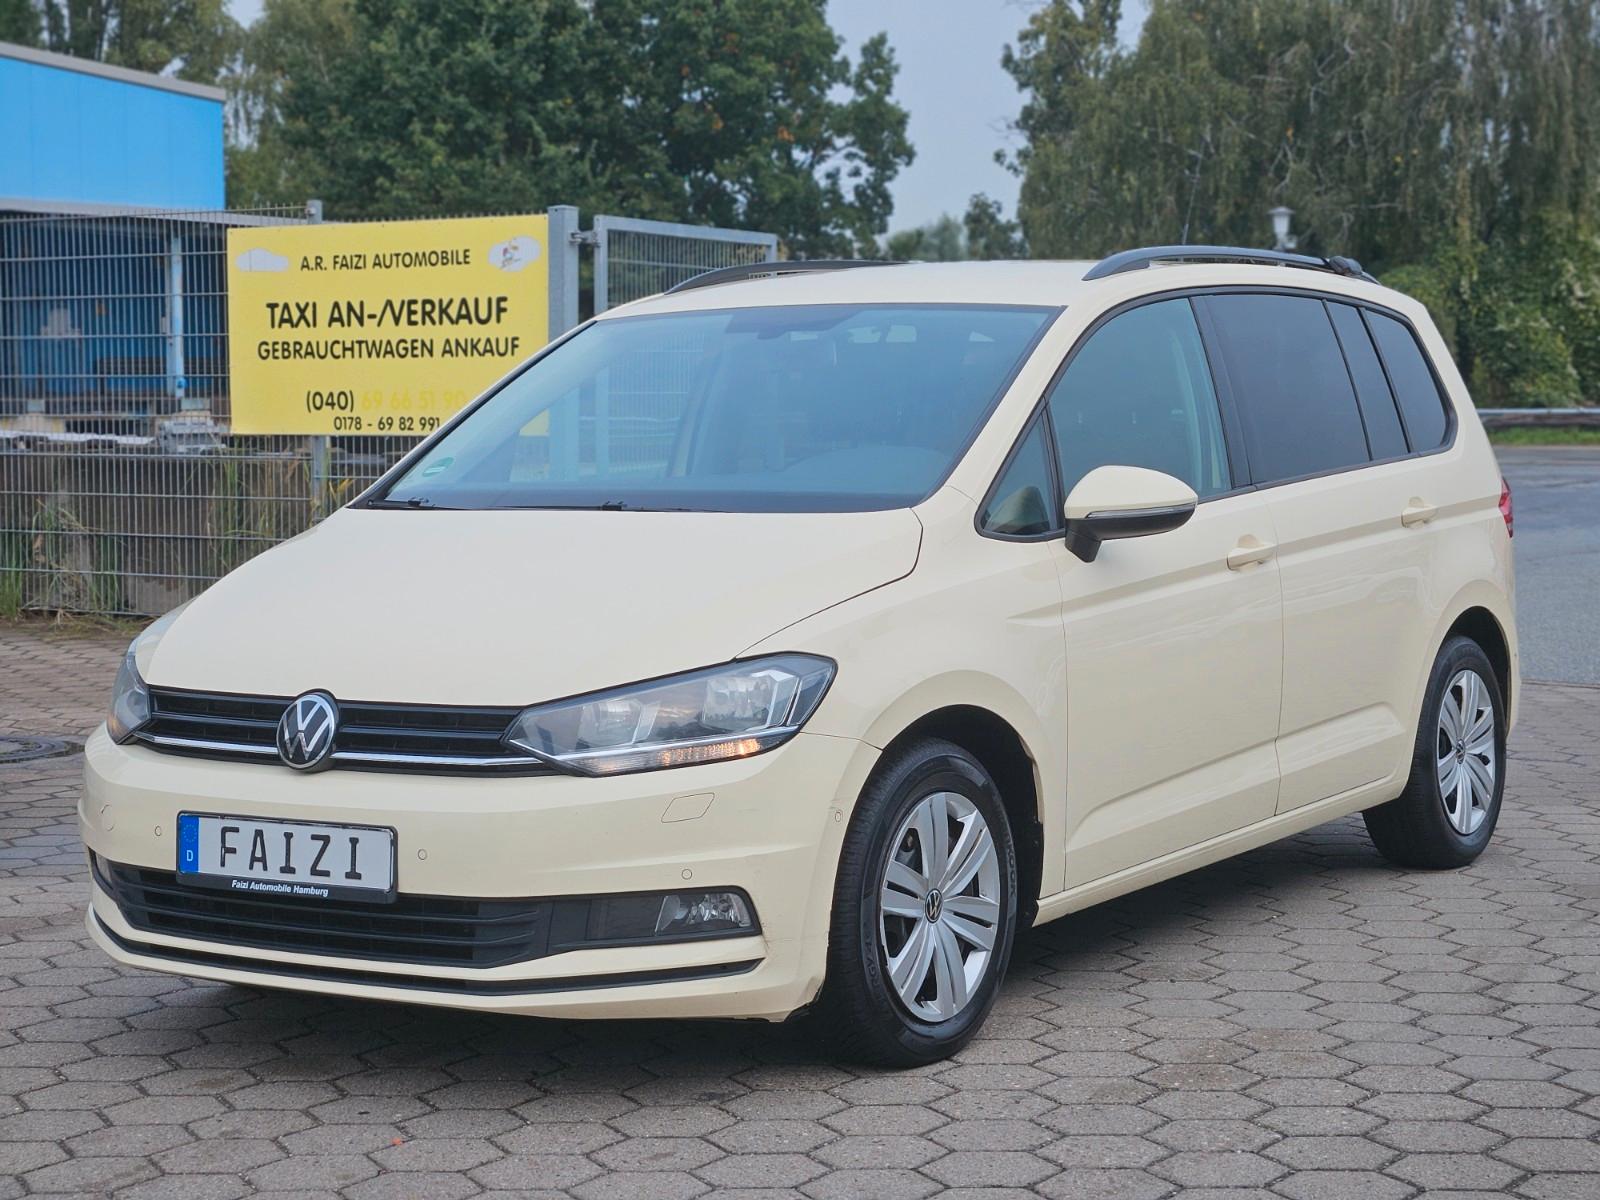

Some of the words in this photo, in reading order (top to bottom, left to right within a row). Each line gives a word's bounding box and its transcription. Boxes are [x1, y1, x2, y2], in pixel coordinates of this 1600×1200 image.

[300, 254, 328, 272] A.R.
[332, 252, 367, 270] FAIZI
[372, 249, 471, 269] AUTOMOBILE
[266, 301, 317, 329] TAXI
[327, 296, 508, 328] AN-/VERKAUF
[257, 339, 435, 361] GEBRAUCHTWAGEN
[441, 336, 520, 358] ANKAUF
[306, 390, 355, 413] (040)
[361, 390, 384, 410] 69
[333, 416, 362, 431] 0178
[378, 416, 394, 431] 69
[398, 416, 415, 431] 82
[186, 850, 194, 862] D
[220, 826, 362, 880] FAIZI
[231, 879, 249, 890] Faizi
[249, 881, 292, 893] Automobile
[293, 884, 329, 897] Hamburg
